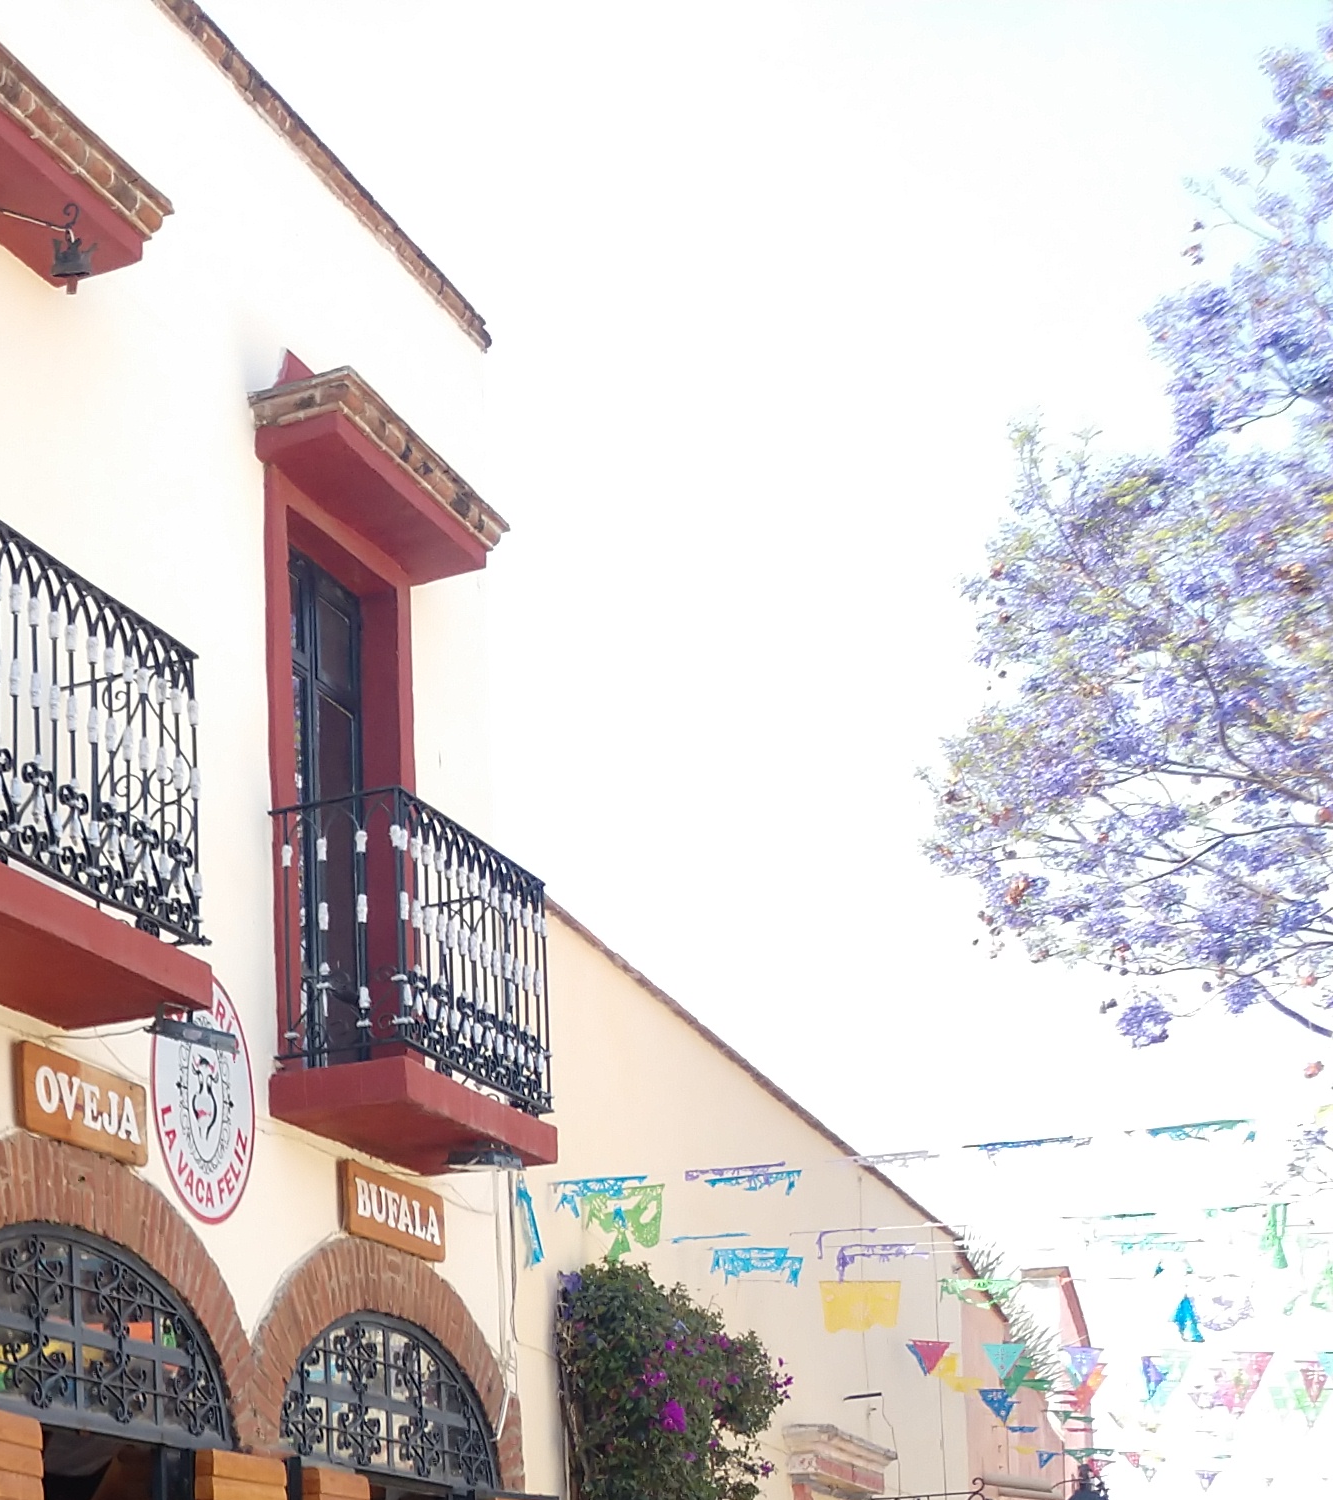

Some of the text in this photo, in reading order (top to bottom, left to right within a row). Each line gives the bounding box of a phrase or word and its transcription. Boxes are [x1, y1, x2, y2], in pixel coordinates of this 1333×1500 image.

[35, 1064, 142, 1145] OVEJA
[159, 1104, 248, 1209] LA VACA FELIZ
[354, 1176, 442, 1247] BUFALA
